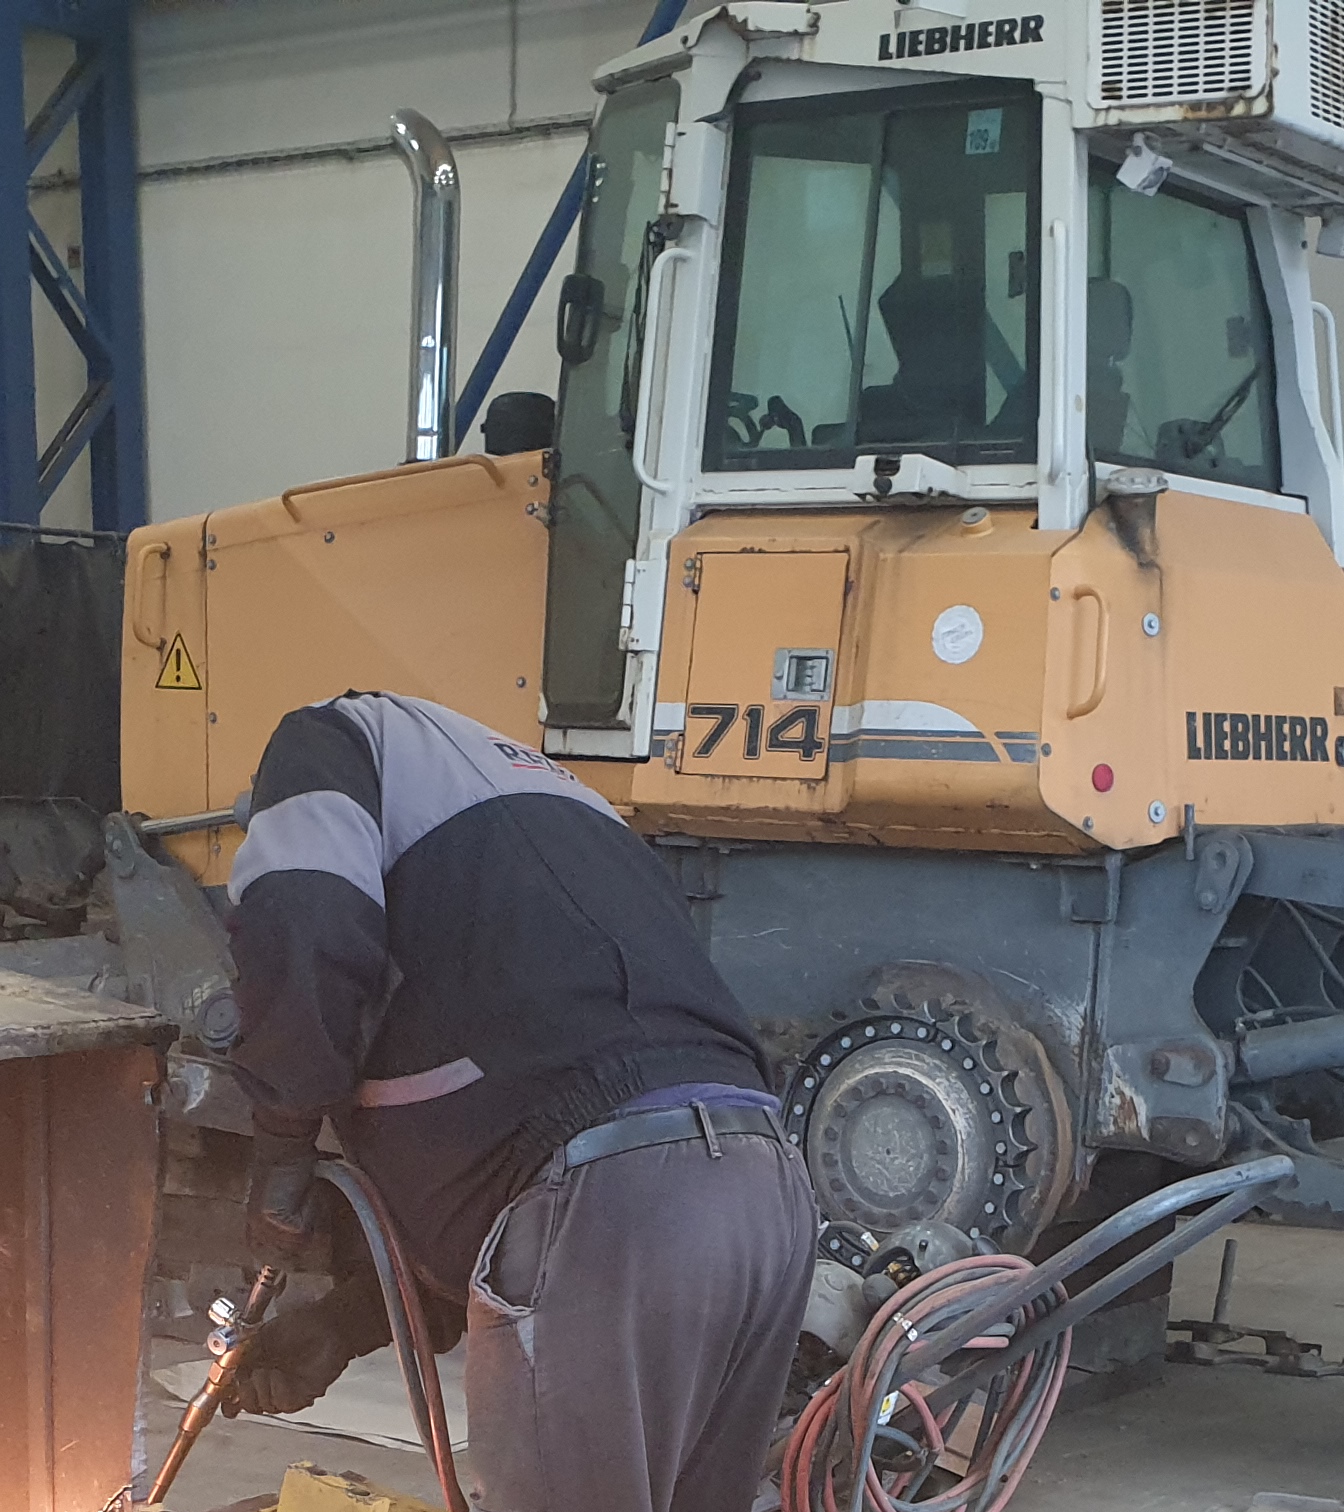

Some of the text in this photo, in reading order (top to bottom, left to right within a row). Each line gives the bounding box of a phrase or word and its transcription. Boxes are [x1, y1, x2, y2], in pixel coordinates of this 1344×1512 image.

[878, 14, 1045, 61] LIEBHERR
[688, 702, 826, 762] 714
[1185, 711, 1330, 762] LIEBHERR
